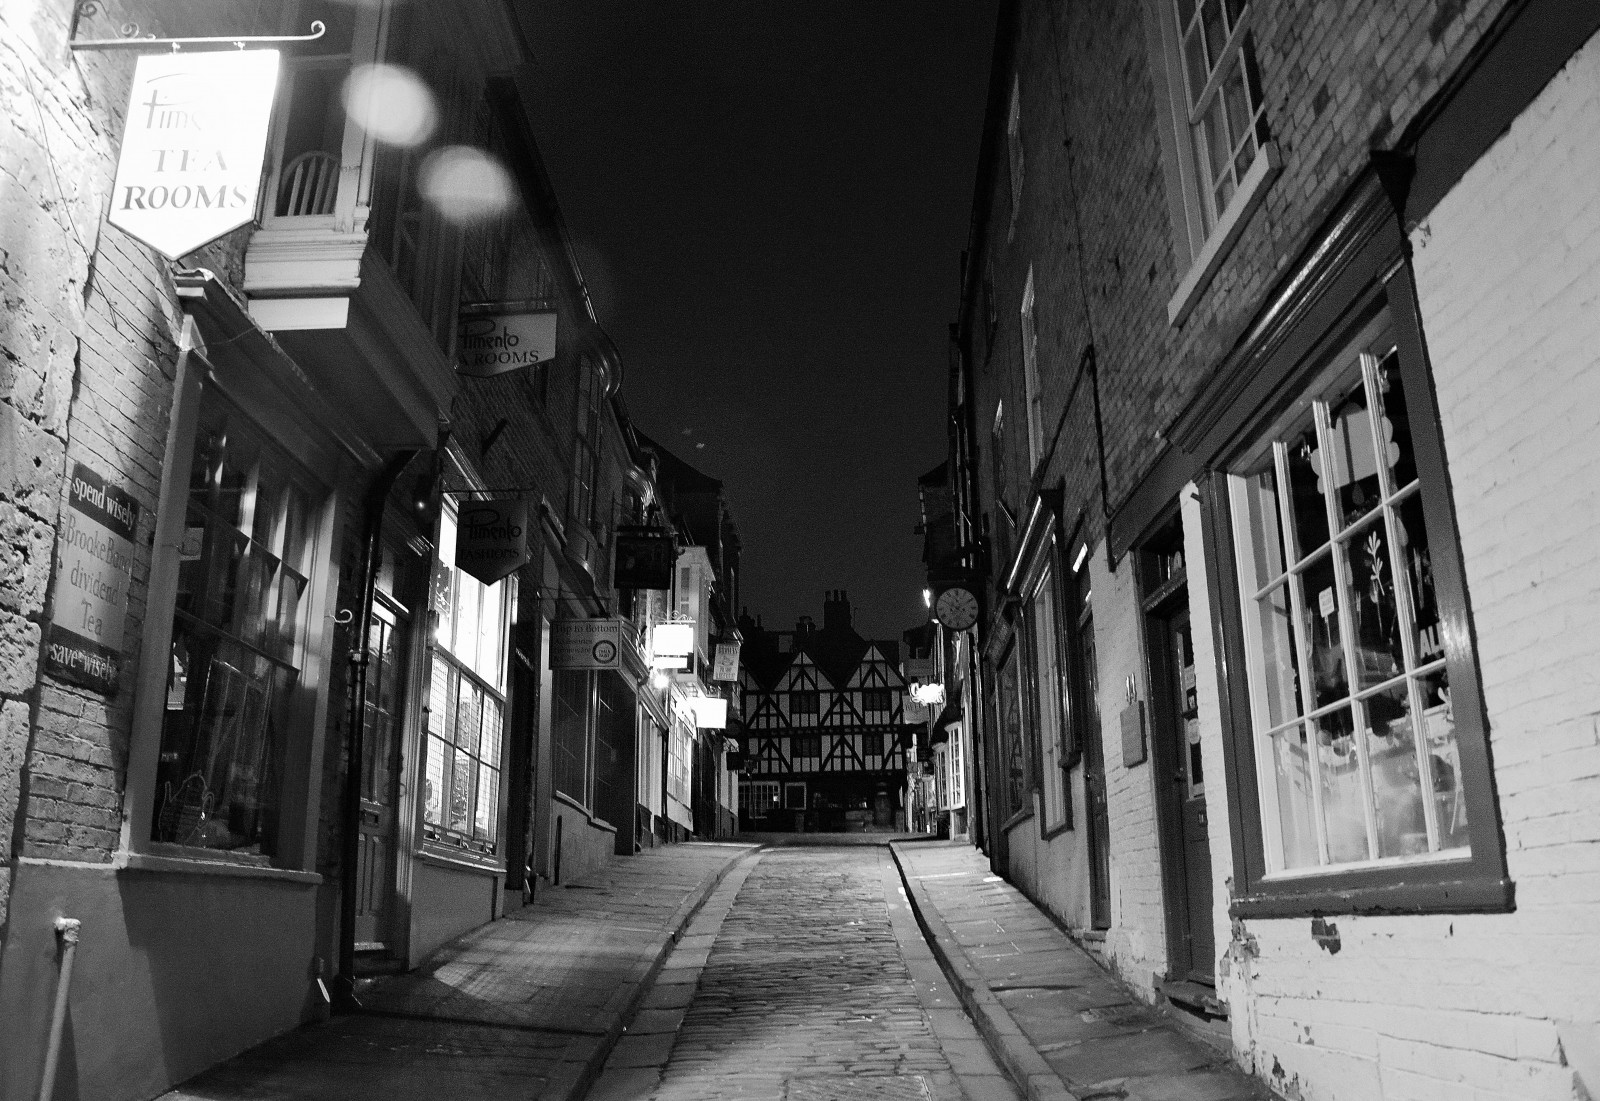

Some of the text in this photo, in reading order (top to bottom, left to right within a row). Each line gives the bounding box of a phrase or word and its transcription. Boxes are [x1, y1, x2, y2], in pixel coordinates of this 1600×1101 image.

[151, 149, 228, 173] TEA
[119, 184, 248, 211] ROOMS
[474, 350, 539, 366] ROOMS
[72, 477, 136, 532] spend wisely
[66, 514, 106, 561] Brooke
[463, 508, 522, 542] Pimento
[71, 559, 121, 606] dividend
[81, 600, 103, 636] Tea
[586, 624, 618, 633] Bottom
[50, 643, 79, 668] save
